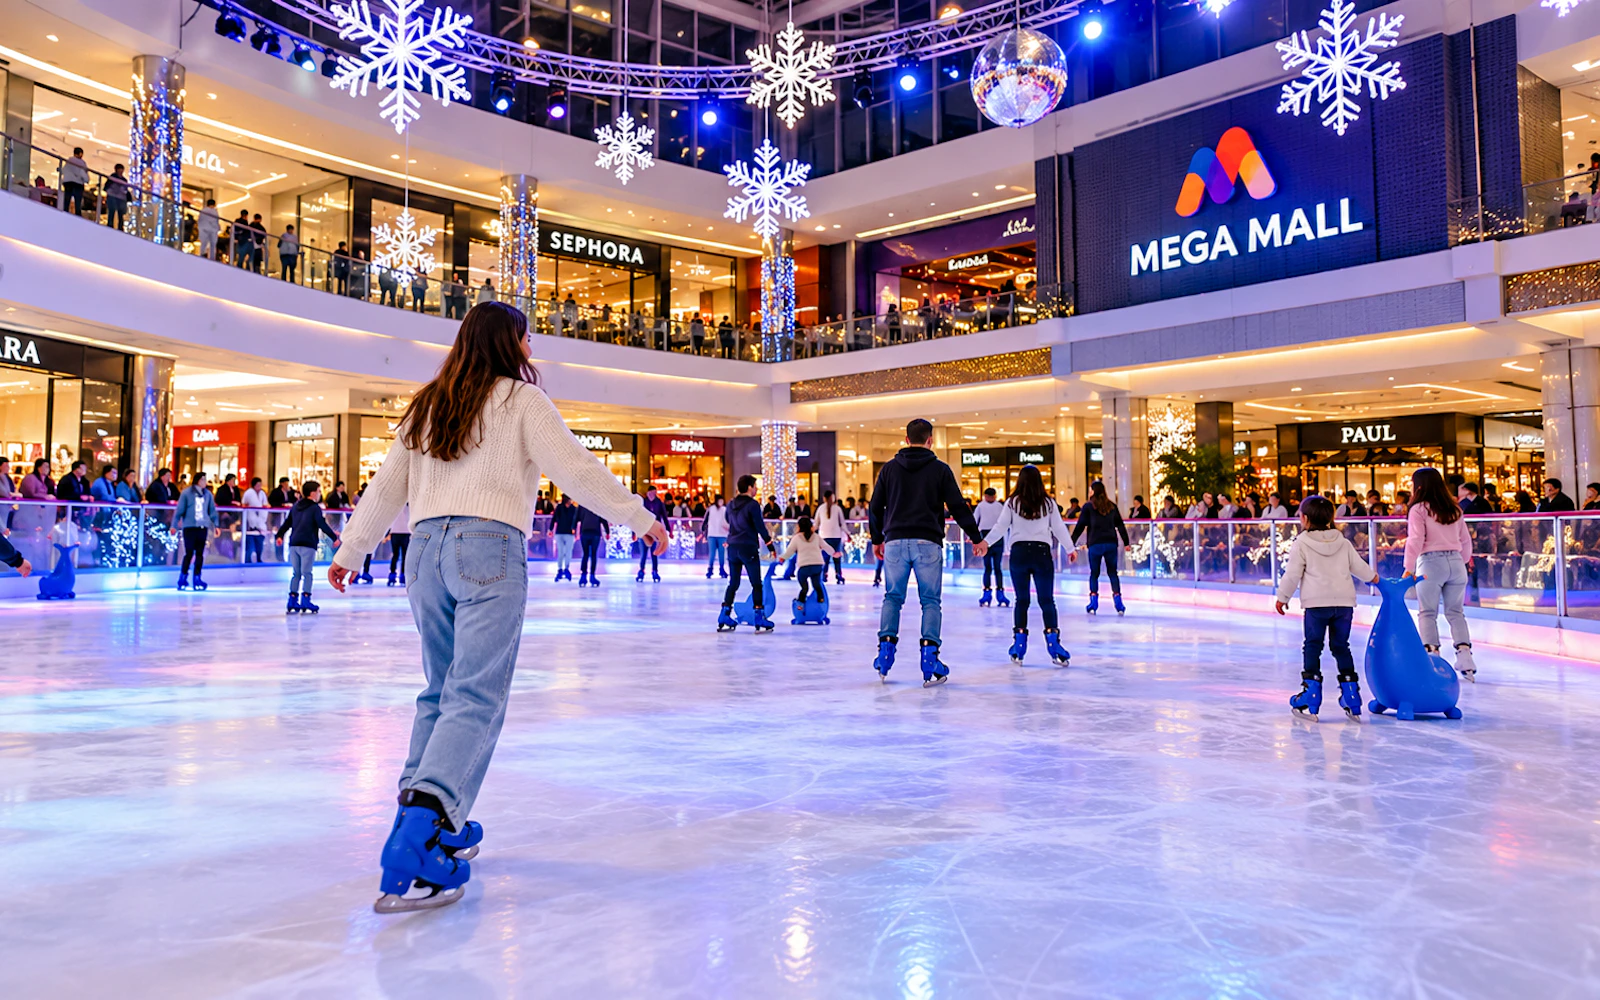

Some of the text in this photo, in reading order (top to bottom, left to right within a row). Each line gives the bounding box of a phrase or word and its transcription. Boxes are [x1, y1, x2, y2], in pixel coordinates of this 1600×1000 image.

[550, 231, 645, 265] SEPHORA
[1130, 197, 1364, 277] MEGA MALL
[0, 335, 41, 365] RA
[1341, 424, 1397, 443] PAUL
